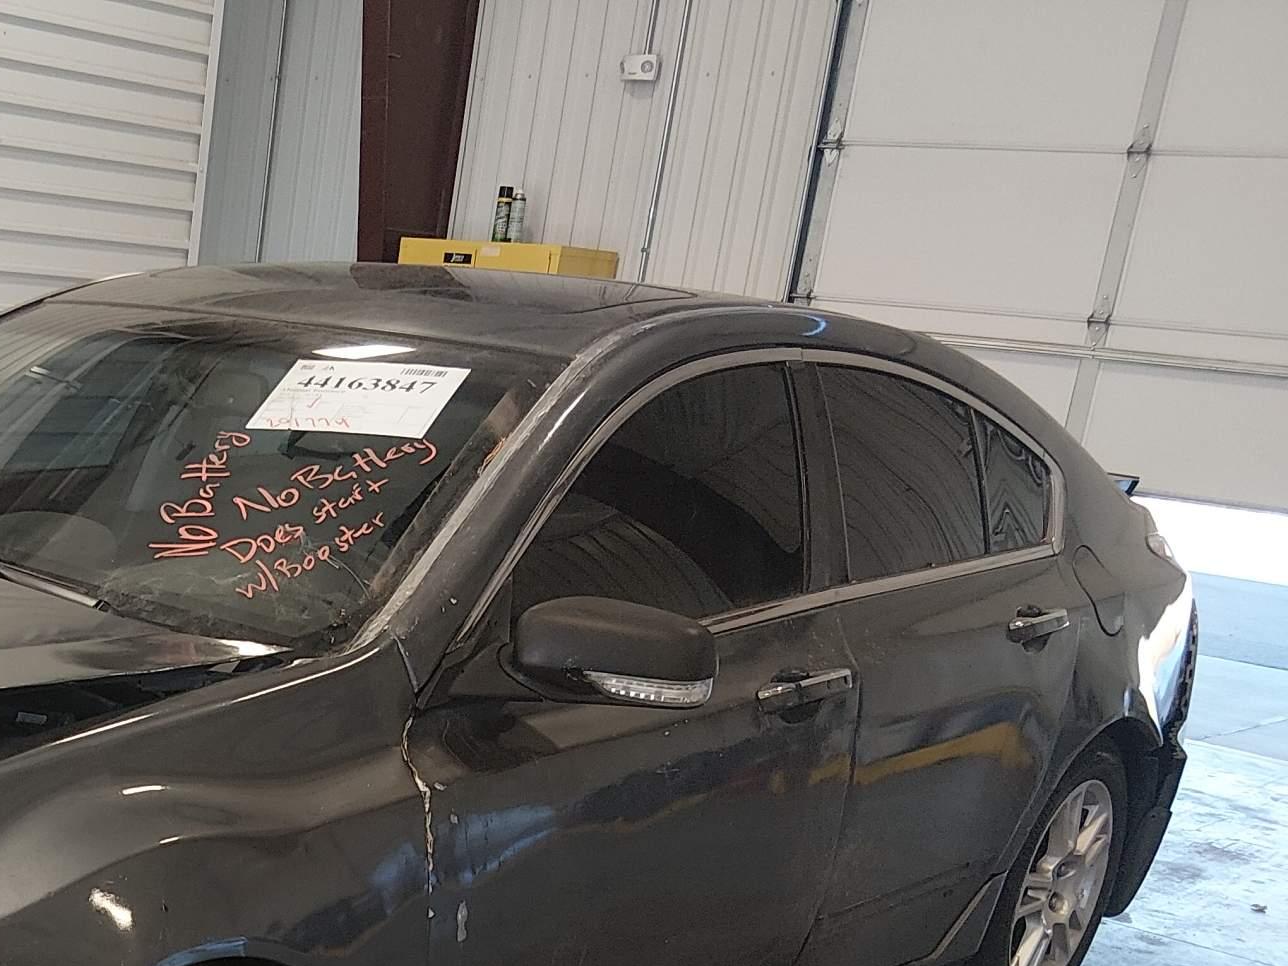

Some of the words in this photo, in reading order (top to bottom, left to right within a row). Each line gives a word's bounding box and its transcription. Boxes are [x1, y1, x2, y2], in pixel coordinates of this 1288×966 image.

[297, 374, 438, 395] 44163847
[159, 431, 251, 524] Battery
[233, 487, 300, 520] No
[148, 525, 217, 559] No
